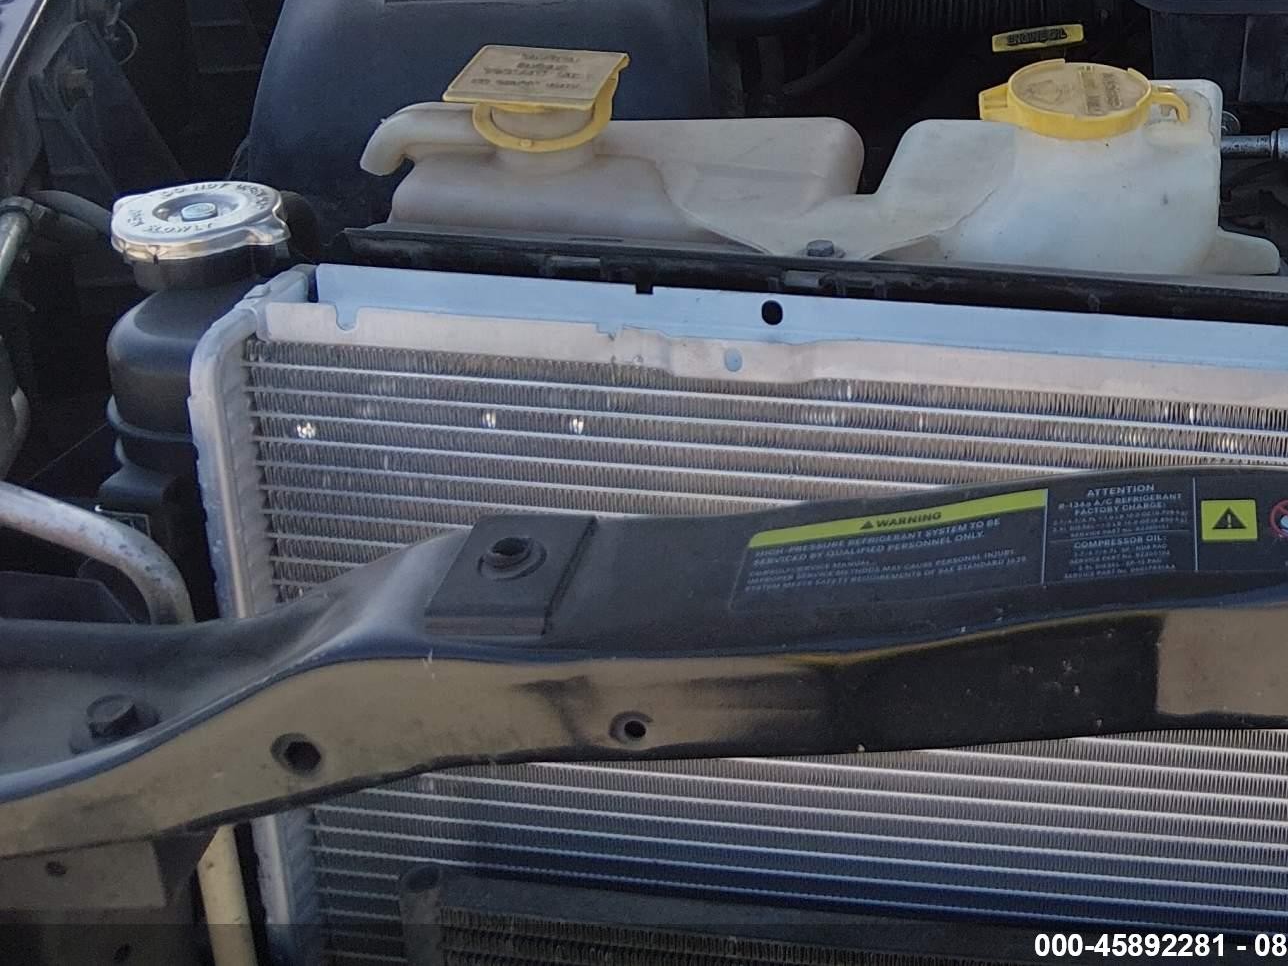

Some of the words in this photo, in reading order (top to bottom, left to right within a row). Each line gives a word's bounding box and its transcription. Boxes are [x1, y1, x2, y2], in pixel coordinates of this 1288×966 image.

[1087, 484, 1155, 497] ATTENTION
[1095, 498, 1113, 507] A/C
[1115, 493, 1182, 504] REFRIGERANT
[1074, 505, 1120, 516] FACTORY
[876, 511, 942, 528] WARNING
[847, 531, 923, 547] REFRIGERANT
[926, 522, 967, 537] SYSTEM
[969, 520, 985, 530] TO
[986, 517, 1001, 528] BE
[826, 544, 885, 557] QUALIFIED
[887, 537, 952, 552] PERSONNEL
[1073, 536, 1143, 549] COMPRESSOR
